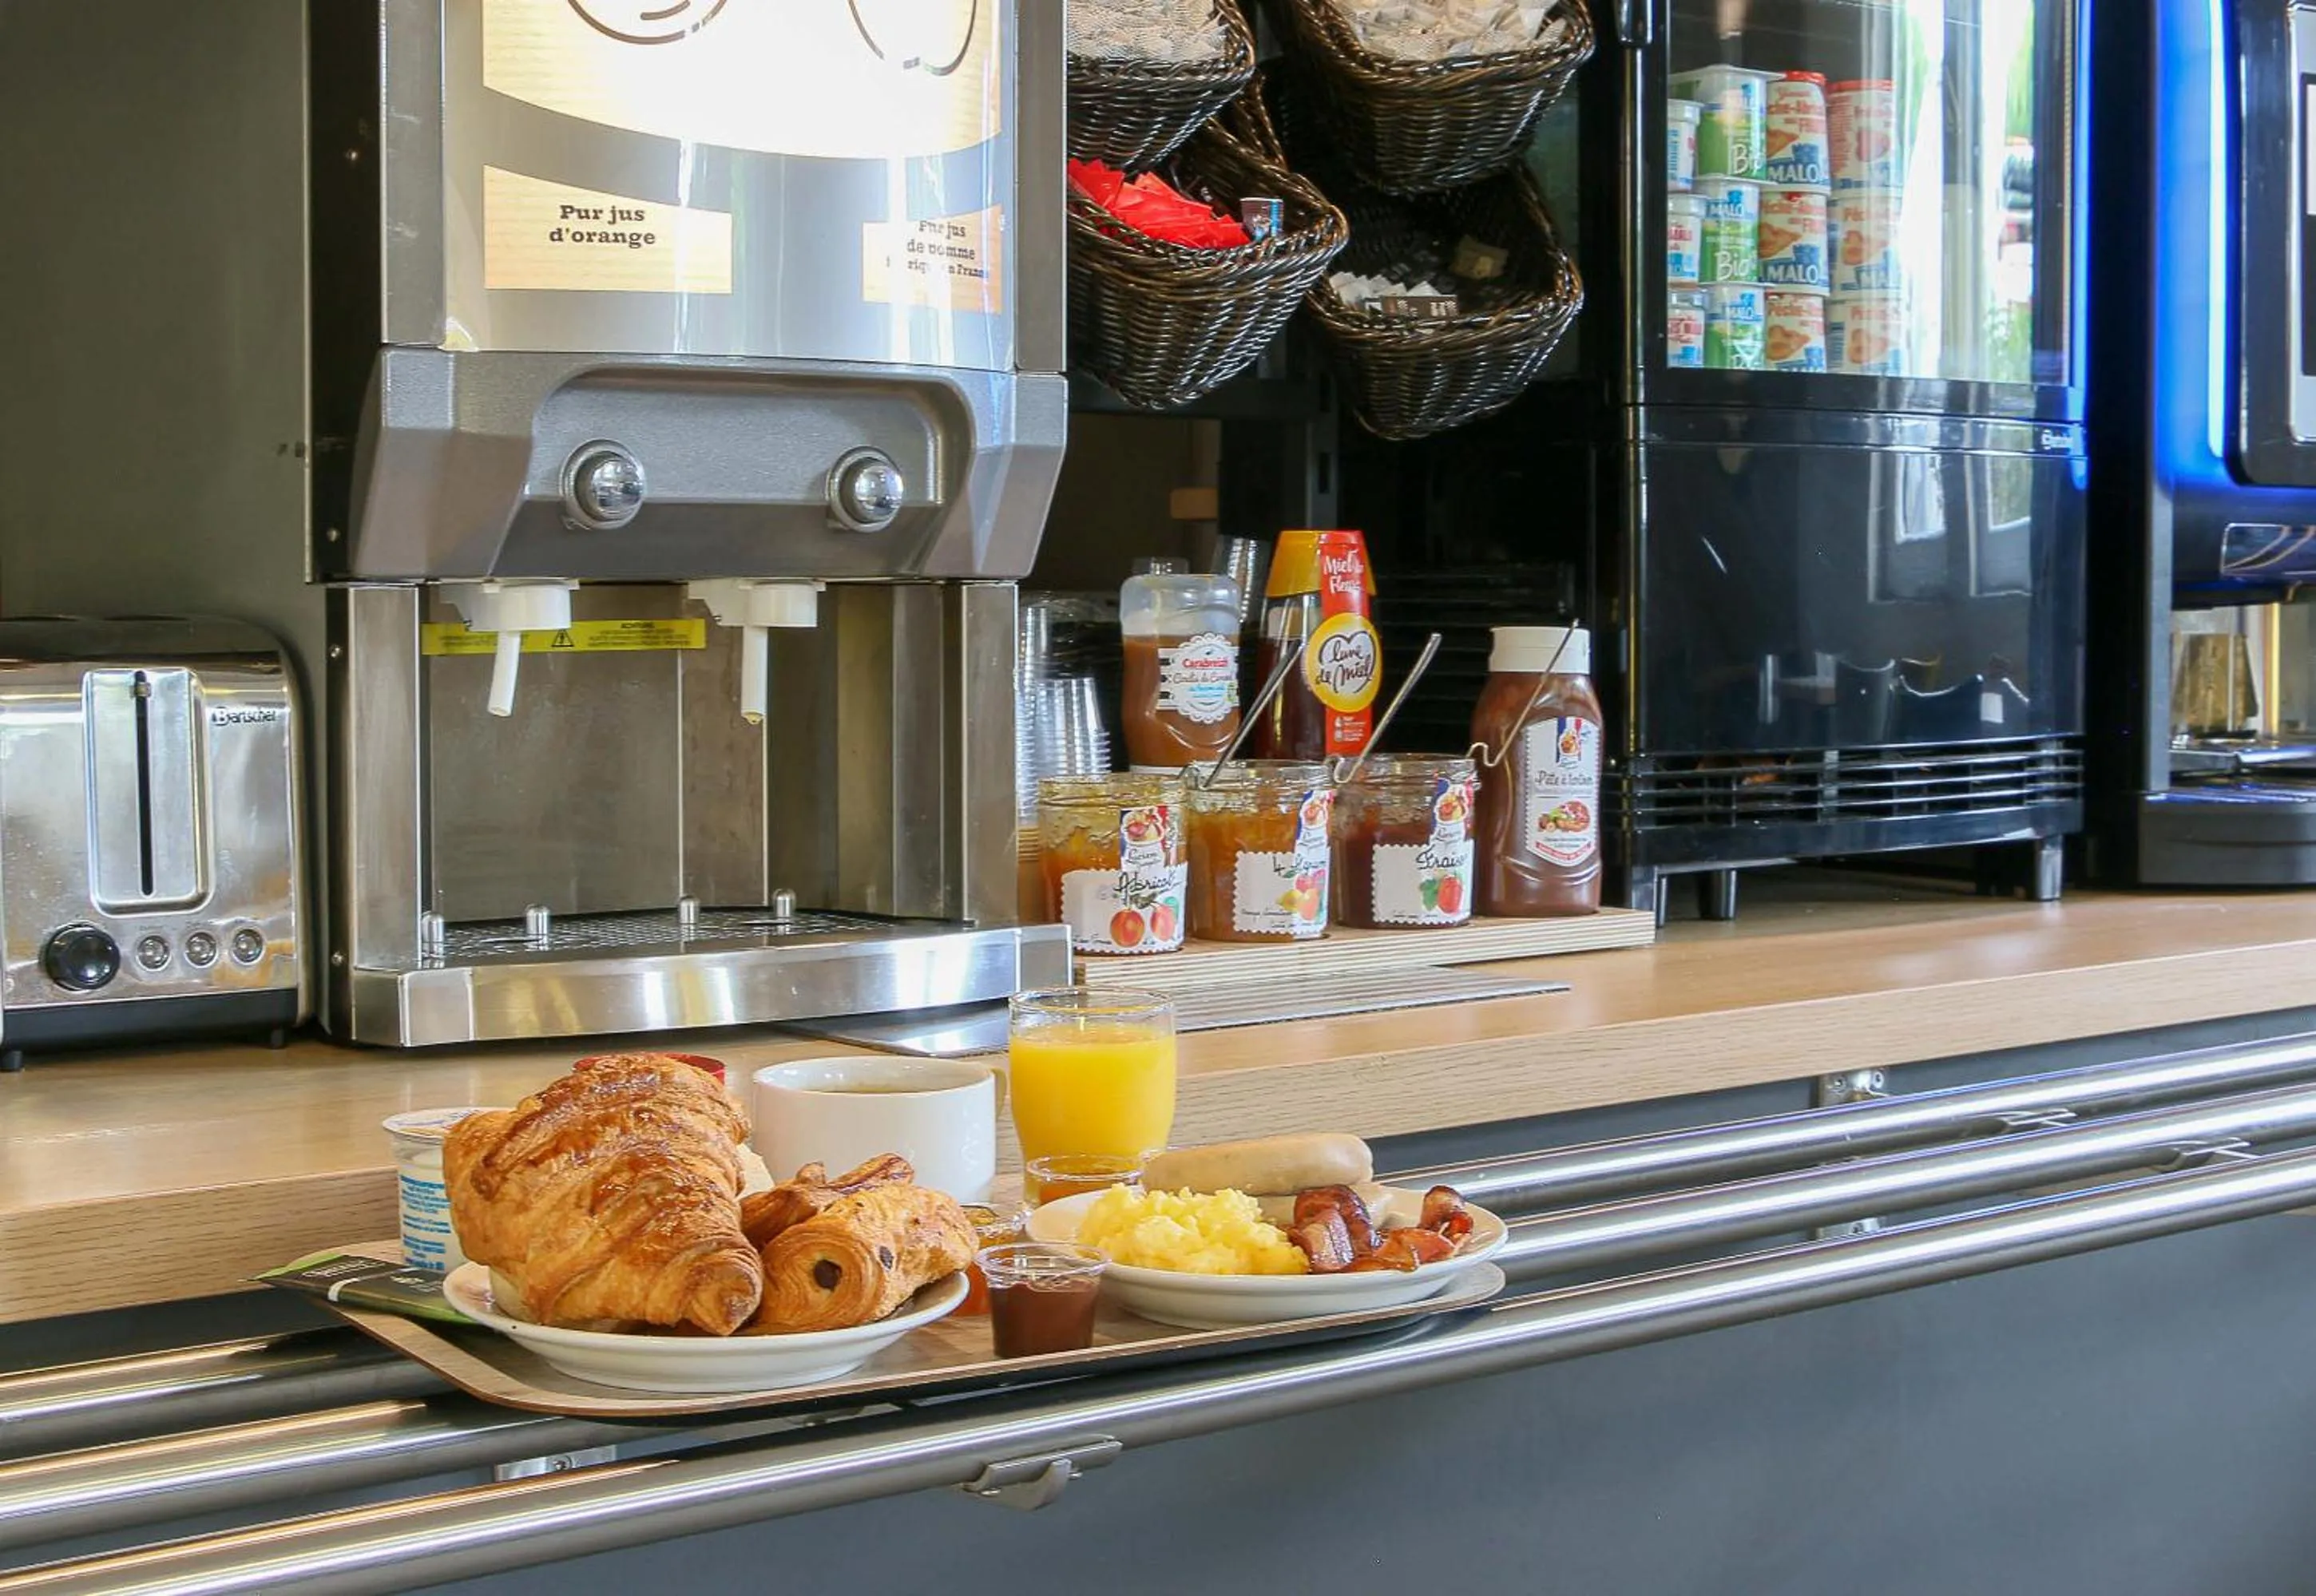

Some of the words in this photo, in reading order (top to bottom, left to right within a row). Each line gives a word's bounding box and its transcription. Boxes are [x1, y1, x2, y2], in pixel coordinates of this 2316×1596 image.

[1767, 163, 1818, 182] MALO
[560, 204, 604, 220] Pur
[607, 204, 645, 225] jus
[549, 228, 656, 249] d'orange
[946, 221, 966, 240] jus
[906, 239, 924, 254] de
[1715, 250, 1751, 280] Bio
[1767, 263, 1818, 283] MALO
